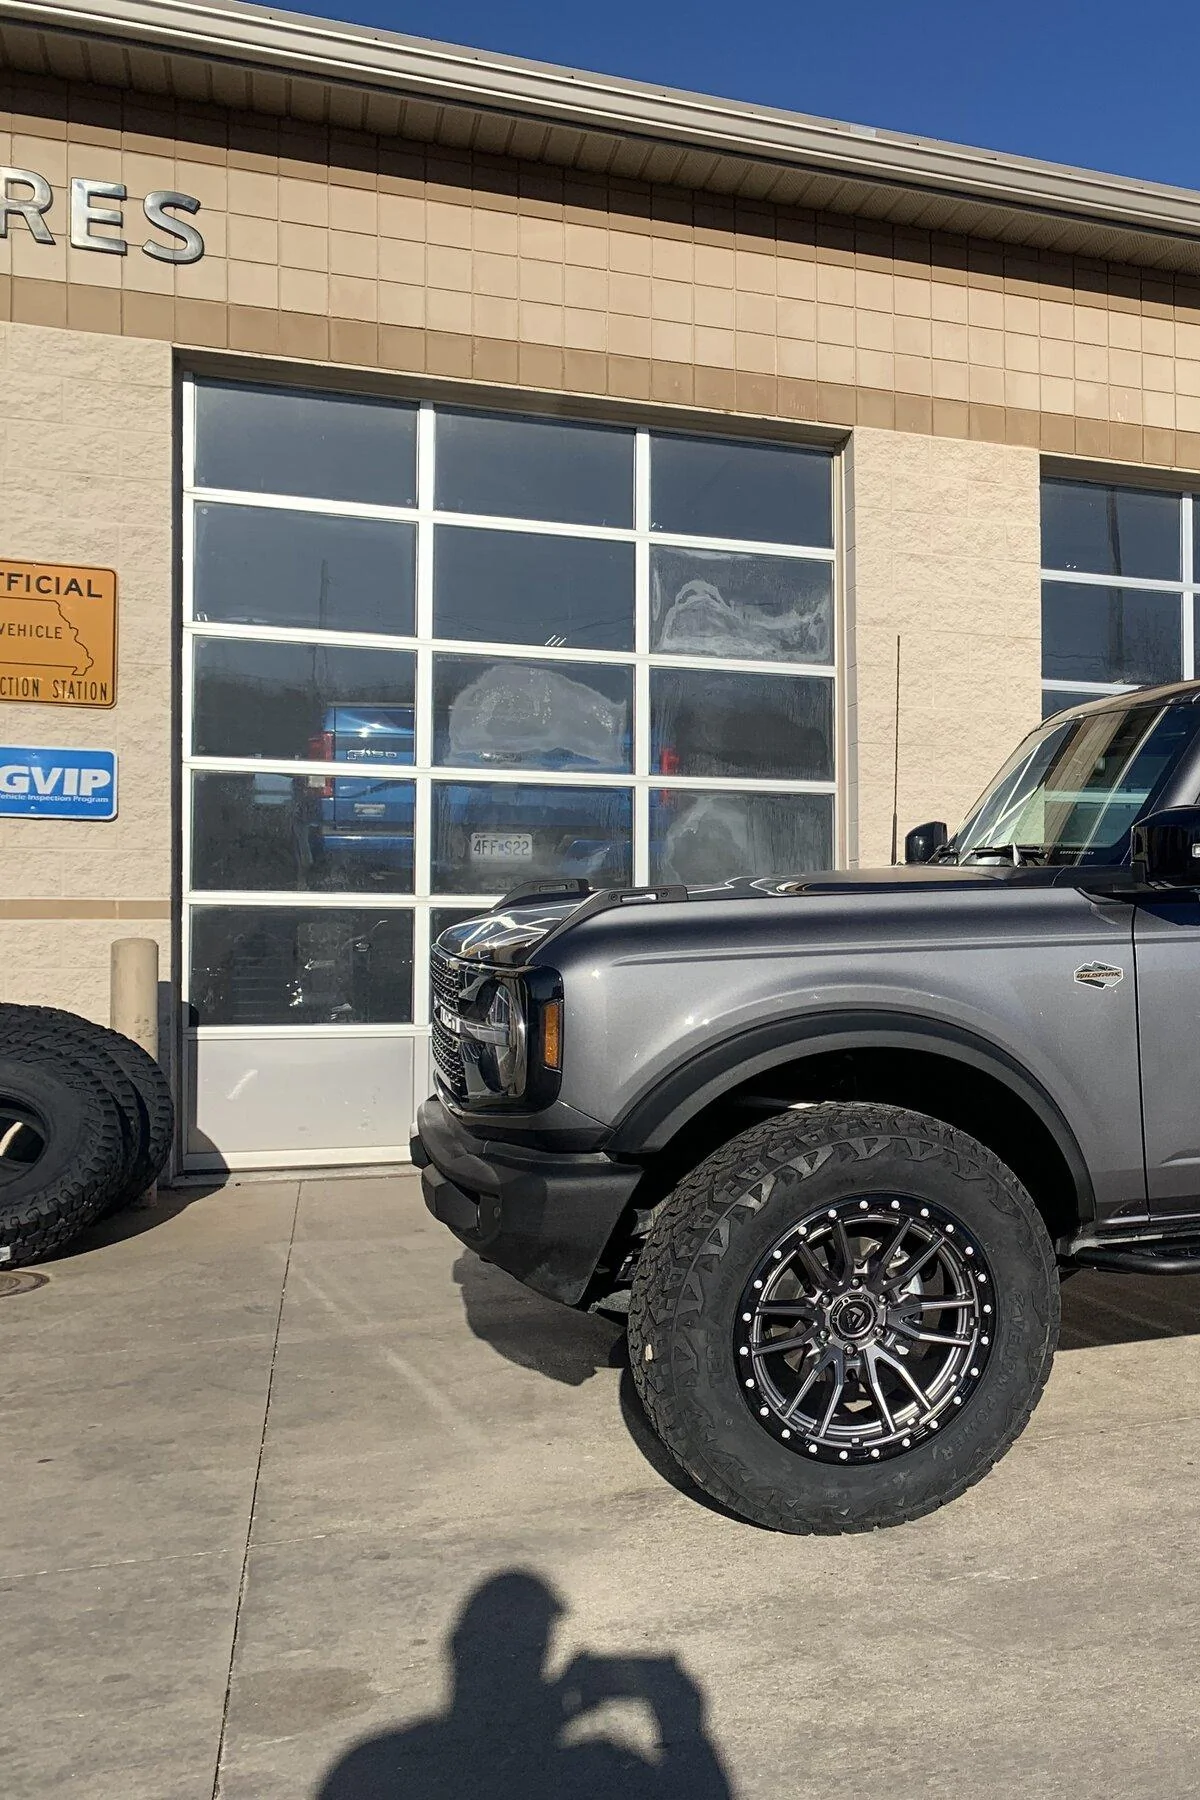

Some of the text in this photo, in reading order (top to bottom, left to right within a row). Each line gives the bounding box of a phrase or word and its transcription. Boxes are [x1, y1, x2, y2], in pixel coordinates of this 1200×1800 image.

[0, 572, 102, 598] FICIAL
[52, 680, 107, 701] STATION
[0, 765, 111, 797] GVIP
[0, 793, 109, 804] ehicle Inspection Program
